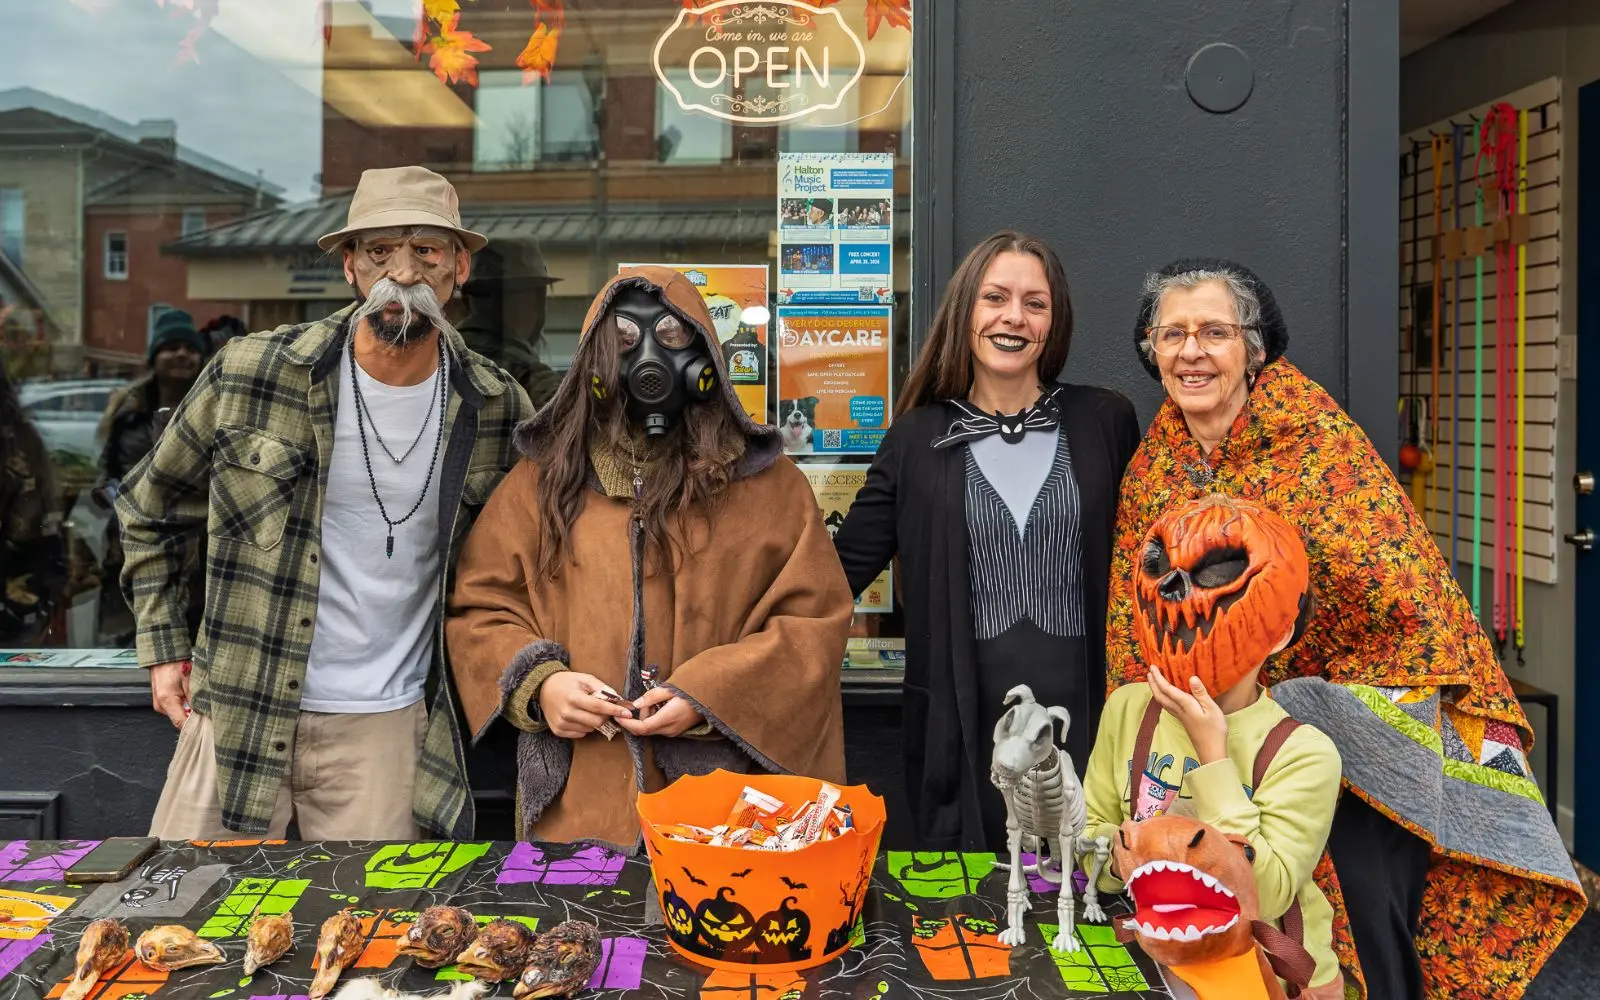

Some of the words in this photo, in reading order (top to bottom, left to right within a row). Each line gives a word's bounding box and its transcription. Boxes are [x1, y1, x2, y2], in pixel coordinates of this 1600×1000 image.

[705, 26, 744, 42] Come
[747, 29, 767, 43] in,
[769, 32, 788, 42] we
[791, 32, 813, 42] are
[689, 46, 829, 88] OPEN
[794, 165, 824, 174] Halton
[794, 175, 821, 184] Music
[794, 184, 826, 193] Project
[814, 320, 835, 328] DOG
[837, 320, 881, 328] DESERVES
